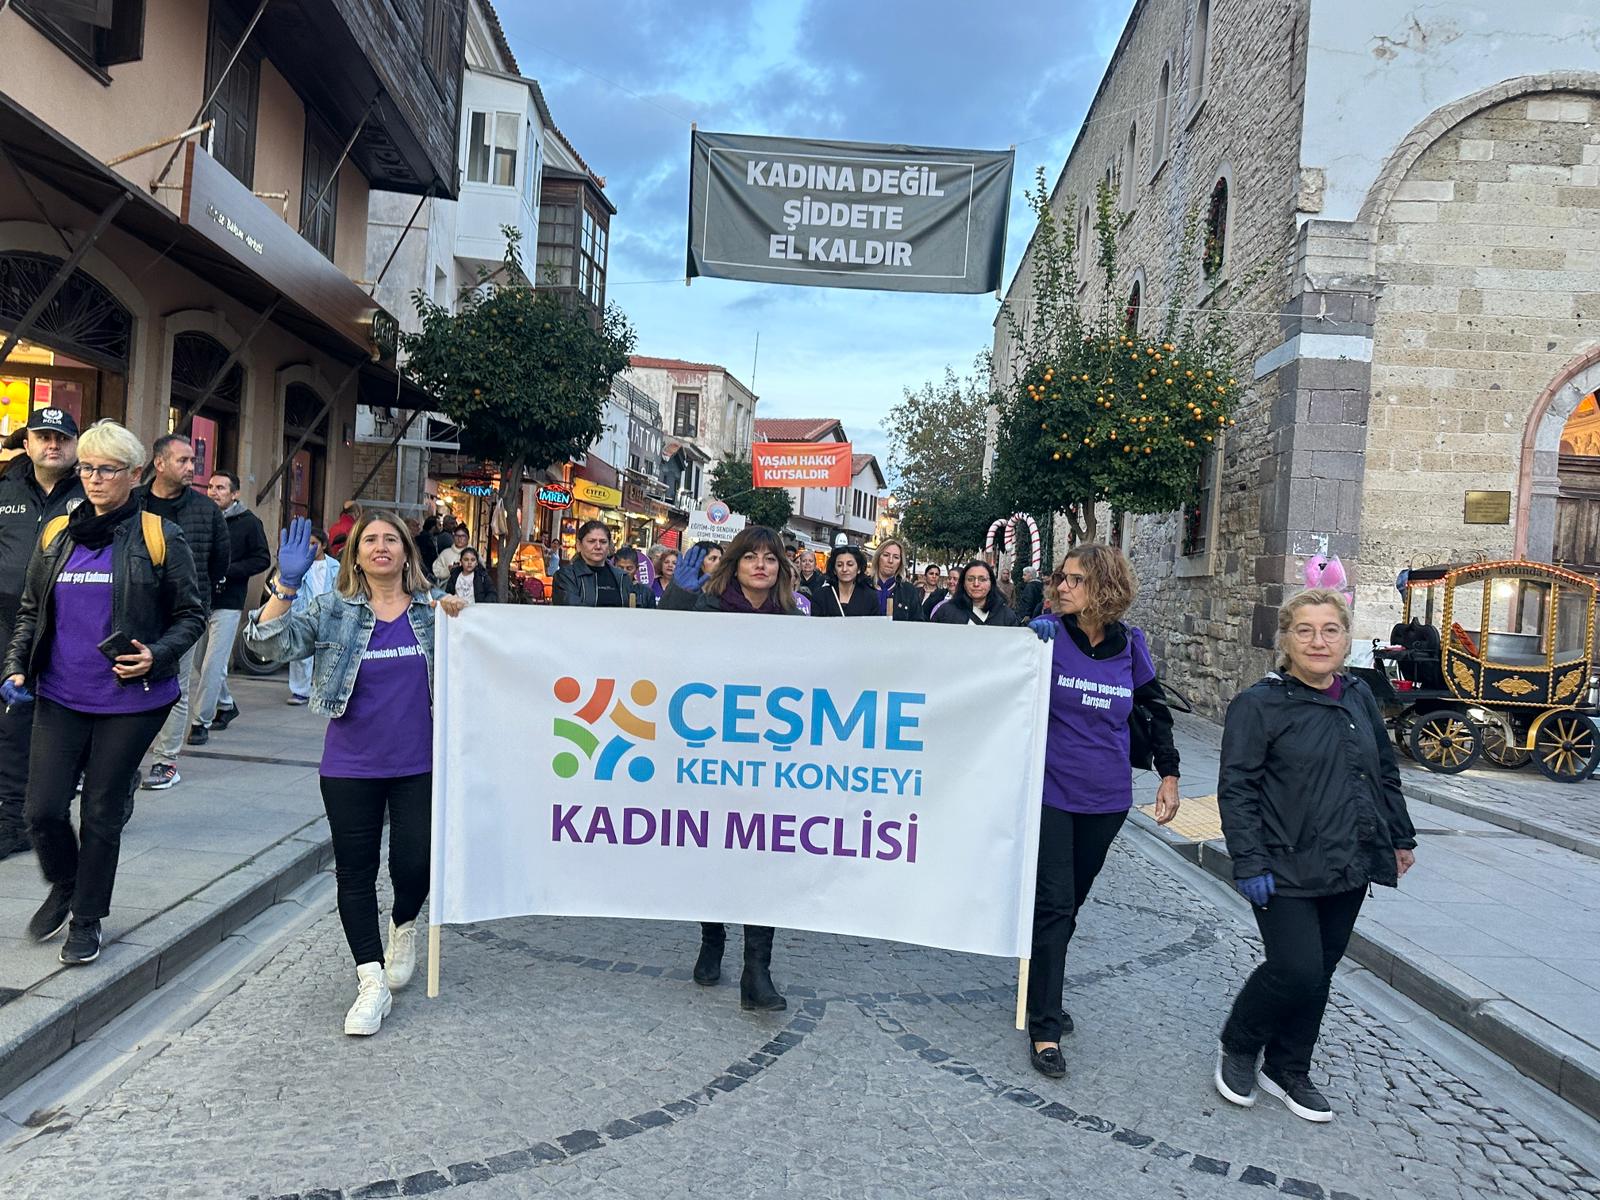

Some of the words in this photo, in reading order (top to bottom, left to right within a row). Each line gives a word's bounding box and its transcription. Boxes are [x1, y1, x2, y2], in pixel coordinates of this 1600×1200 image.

[746, 160, 856, 193] KADINA
[861, 165, 945, 197] DEĞİL
[783, 196, 904, 231] ŞİDDETE
[769, 234, 802, 260] EL
[808, 238, 912, 267] KALDIR
[630, 419, 661, 456] TATTOO
[757, 455, 798, 469] YAŞAM
[799, 455, 836, 467] HAKKI
[764, 469, 829, 480] KUTSALDIR
[668, 682, 926, 752] ÇEŞME
[676, 757, 767, 787] KENT
[774, 762, 922, 796] KONSEYİ
[552, 804, 709, 848] KADIN
[724, 809, 918, 863] MECLİSİ
